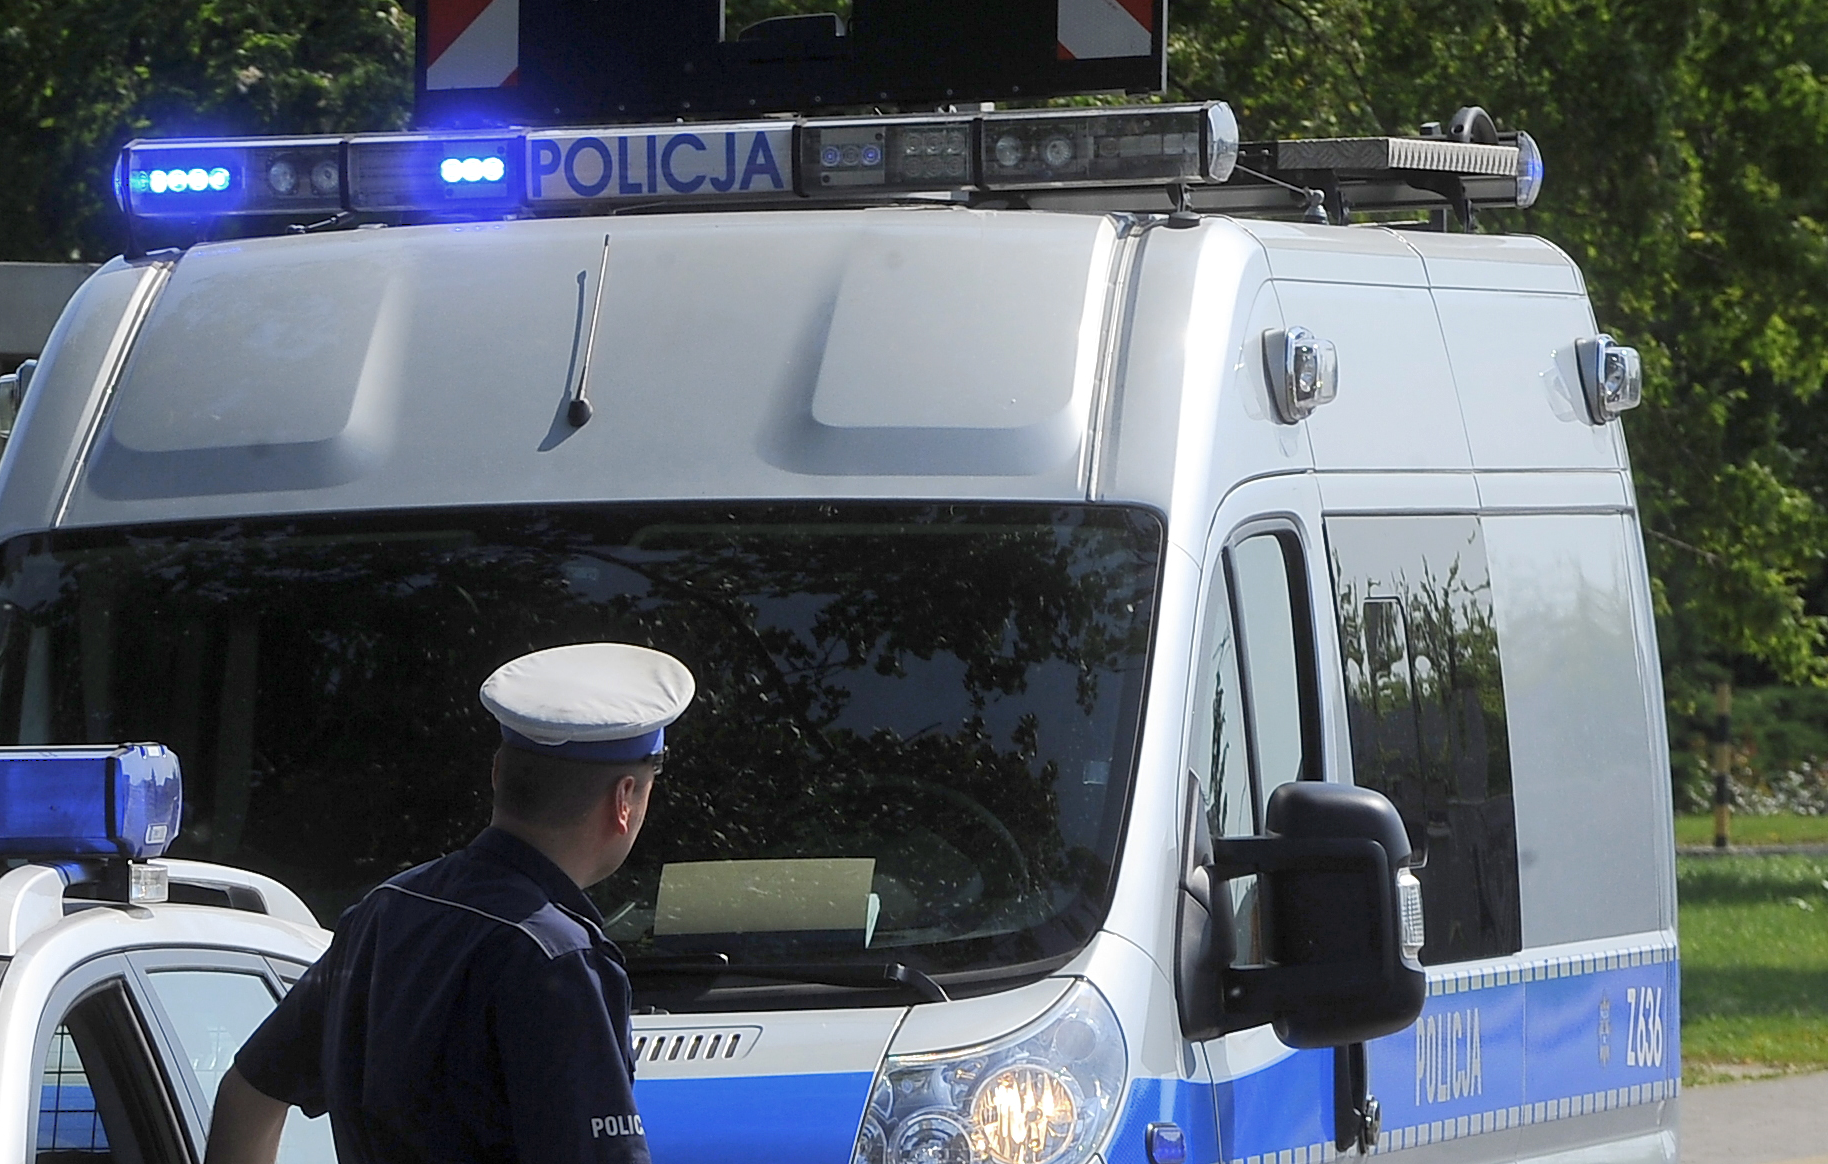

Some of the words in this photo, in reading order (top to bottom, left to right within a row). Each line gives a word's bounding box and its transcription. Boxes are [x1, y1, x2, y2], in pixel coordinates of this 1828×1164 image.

[530, 130, 784, 198] POLICJA
[1415, 1007, 1482, 1107] POLICJA
[590, 1114, 645, 1139] POLIC
